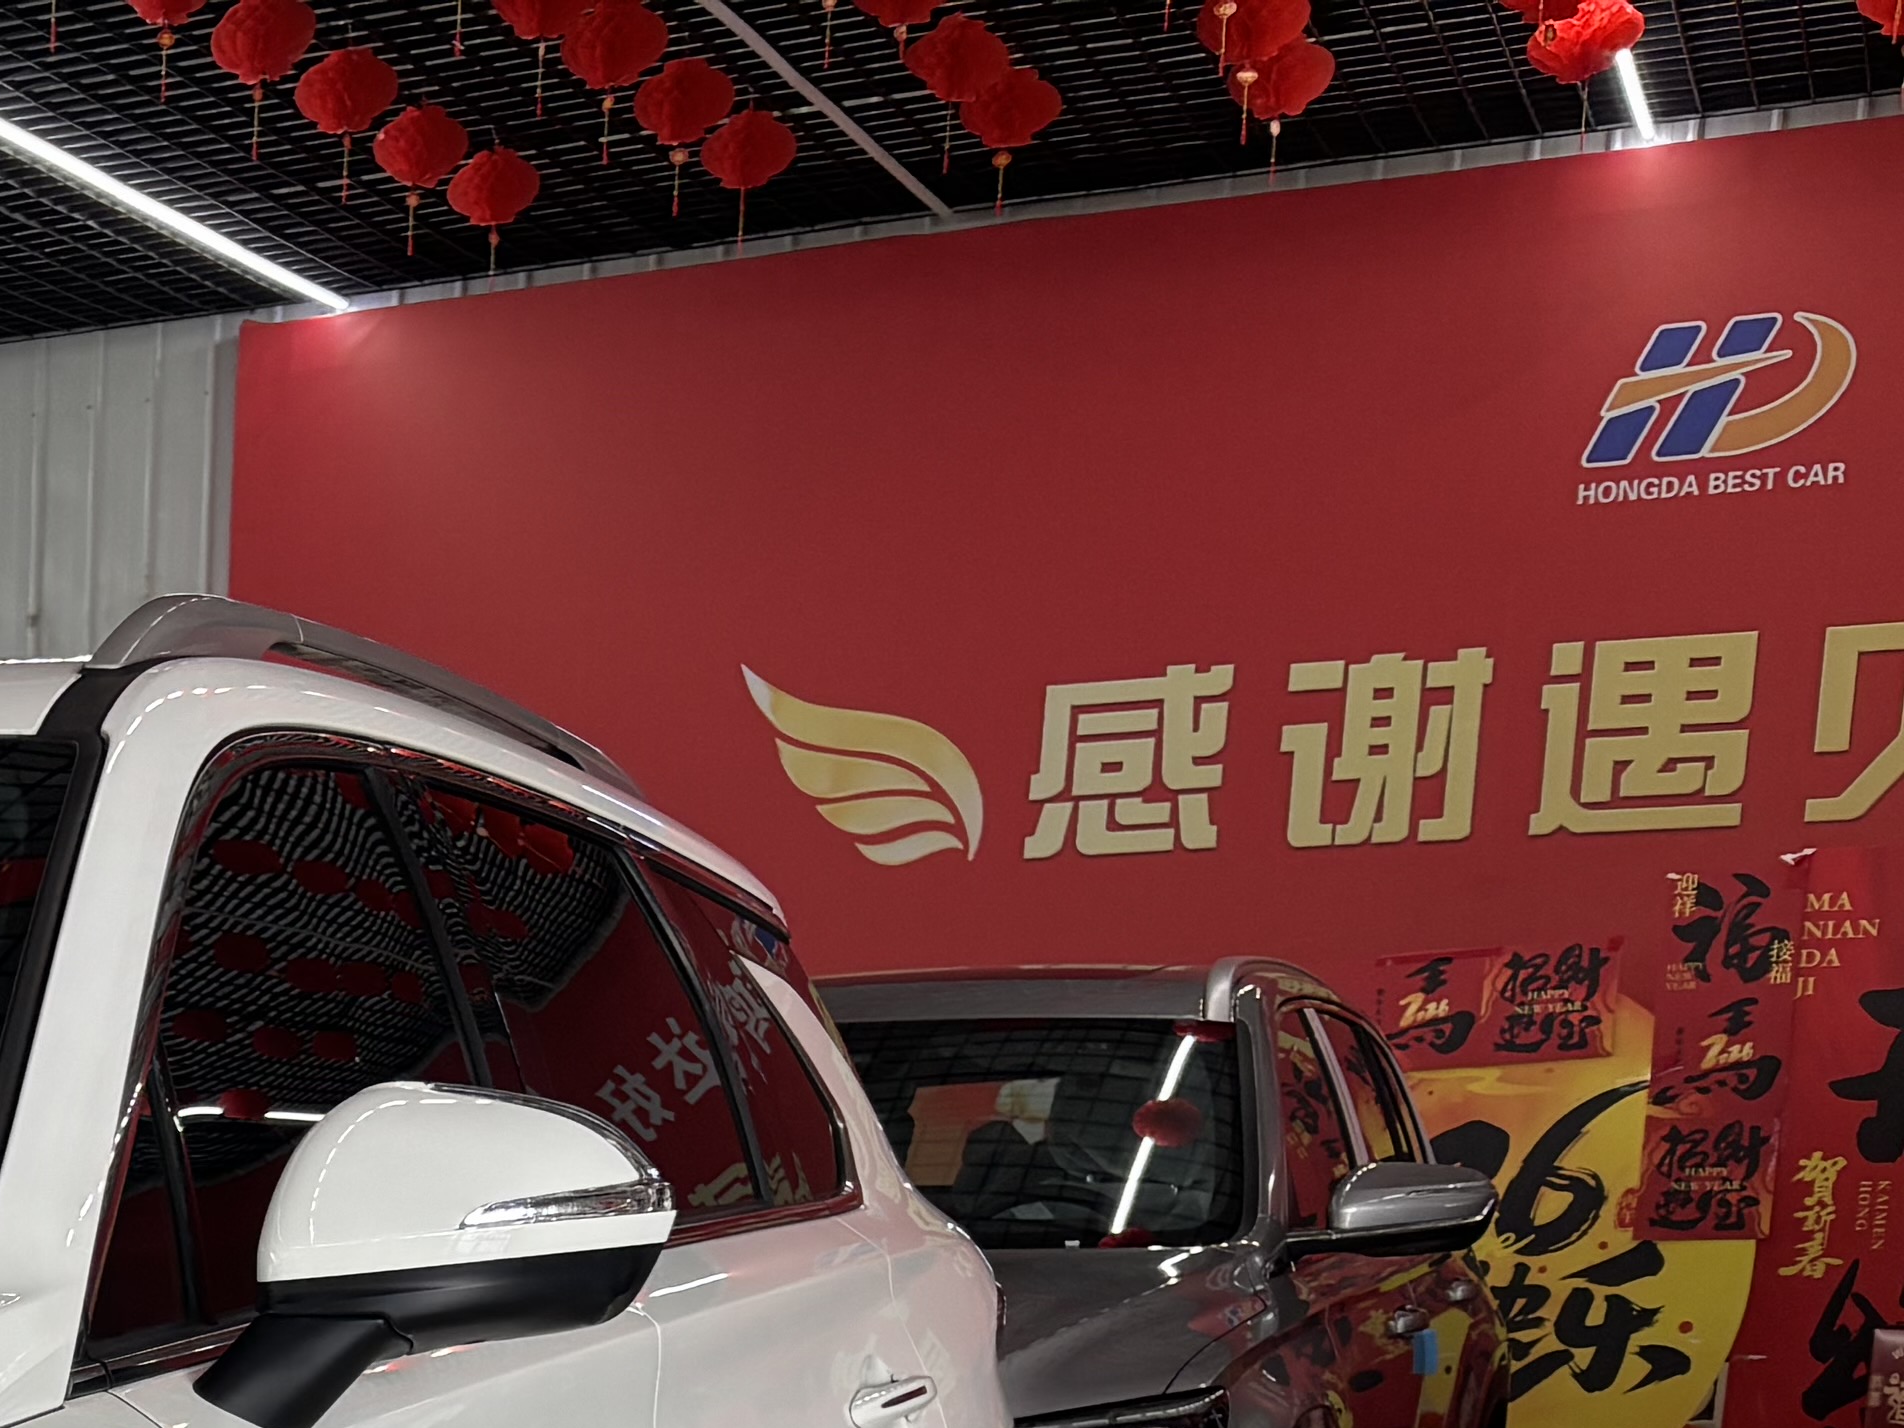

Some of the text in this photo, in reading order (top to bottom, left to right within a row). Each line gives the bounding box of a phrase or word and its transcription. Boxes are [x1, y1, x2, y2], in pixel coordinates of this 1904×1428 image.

[1576, 462, 1846, 504] HONGDA BEST CAR
[1804, 892, 1853, 912] MA
[1672, 873, 1791, 984] 福
[1803, 919, 1880, 940] NIAN
[1800, 948, 1841, 967] DA
[1794, 977, 1816, 999] JI
[1686, 1166, 1728, 1177] HAPPY
[1672, 1180, 1699, 1191] NEW
